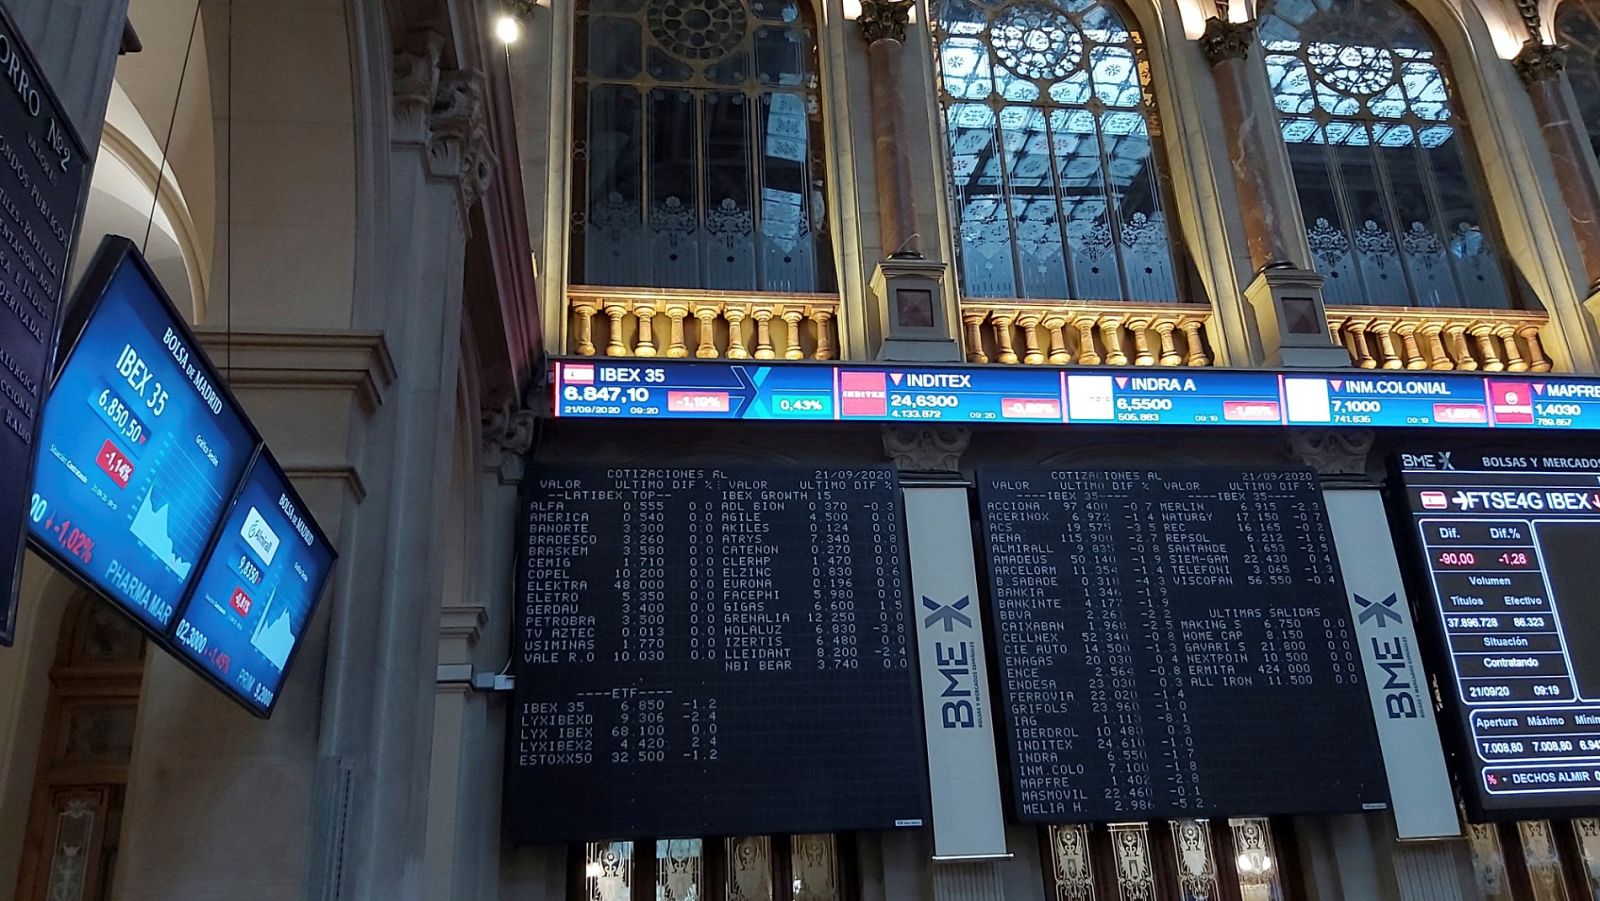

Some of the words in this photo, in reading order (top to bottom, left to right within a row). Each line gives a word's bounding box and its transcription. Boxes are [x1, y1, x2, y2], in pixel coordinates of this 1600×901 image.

[163, 327, 187, 369] BOLSA
[193, 370, 223, 415] MADRID
[600, 368, 641, 382] IBEX
[645, 368, 665, 382] 35
[116, 343, 153, 398] IBEX
[146, 382, 169, 416] 35
[907, 374, 971, 388] INDITEX
[1132, 378, 1181, 391] INDRA
[1183, 379, 1196, 391] A
[1345, 381, 1451, 395] INM.COLONIAL
[1547, 384, 1600, 398] MAPFRE
[564, 387, 649, 403] 6.847,10
[891, 395, 959, 408] 24,6300
[1117, 398, 1172, 411] 6,5500
[564, 406, 620, 415] 21/09/2020
[1332, 401, 1380, 413] 7,1000
[98, 389, 142, 443] 6.850,50
[1402, 454, 1435, 467] BME
[1482, 457, 1527, 467] BOLSAS
[1530, 457, 1538, 467] Y
[105, 452, 133, 482] -1,14%
[607, 469, 703, 478] COTIZACIONES
[815, 470, 891, 480] 21/09/2020
[1242, 472, 1312, 481] 21/09/2020
[540, 480, 581, 489] VALOR
[615, 480, 664, 489] ULTIMO
[672, 480, 695, 489] DIF
[722, 491, 753, 500] IBEX
[761, 491, 808, 500] GROWTH
[817, 491, 831, 500] 15
[987, 502, 1040, 510] ACCIONA
[1467, 492, 1543, 509] FTSE4G
[1545, 493, 1592, 510] IBEX
[530, 502, 564, 511] ALFA
[1160, 503, 1205, 511] MERLIN
[530, 513, 589, 522] AMERICA
[721, 513, 761, 521] AGILE
[989, 513, 1049, 521] ACERINOX
[1161, 513, 1213, 522] NATURGY
[529, 524, 589, 533] BANORTE
[722, 524, 769, 532] AKILES
[990, 523, 1012, 532] ACS
[1164, 523, 1186, 532] REC
[722, 534, 762, 543] ATRYS
[991, 534, 1021, 542] AENA
[1166, 534, 1210, 542] REPSOL
[1439, 528, 1461, 539] Dif.
[1490, 528, 1520, 539] Dif.%
[529, 535, 597, 545] BRADESCO
[529, 546, 588, 556] BRASKEM
[722, 546, 779, 554] CATENON
[992, 545, 1053, 553] ALMIRALL
[1168, 544, 1226, 553] SANTANDE
[528, 558, 571, 567] CEMIG
[722, 557, 771, 565] CLERHP
[993, 555, 1047, 564] AMADEUS
[1169, 555, 1229, 563] SIEM-GAM
[1439, 553, 1475, 565] -90,00
[1499, 553, 1527, 564] -1,28
[527, 569, 570, 579] COPEL
[723, 568, 771, 577] ELZINC
[995, 566, 1057, 575] ARCELORM
[1172, 566, 1230, 574] TELEFONI
[723, 579, 772, 589] EURONA
[1173, 576, 1233, 585] VISCOFAN
[1469, 577, 1511, 586] Volumen
[527, 581, 588, 591] ELEKTRA
[723, 590, 779, 600] FACEPHI
[997, 588, 1044, 597] BANKIA
[527, 593, 579, 603] ELETRO
[1504, 596, 1542, 606] Efectivo
[526, 604, 578, 614] GERDAU
[724, 602, 765, 611] GIGAS
[999, 599, 1061, 609] BANKINTE
[724, 613, 790, 623] GRENALIA
[1000, 611, 1031, 620] BBVA
[1209, 608, 1262, 618] ULTIMAS
[1269, 608, 1321, 617] SALIDAS
[525, 616, 595, 626] PETROBRA
[724, 625, 782, 635] HOLALUZ
[1002, 622, 1064, 632] CAIXABAN
[726, 637, 783, 647] IZERTIS
[1003, 633, 1058, 643] CELLNEX
[1484, 637, 1528, 646] Situación
[524, 640, 595, 650] USIMINAS
[725, 648, 791, 659] LLEIDANT
[1186, 653, 1248, 663] NEXTPOIN
[1006, 656, 1053, 666] ENAGAS
[1484, 658, 1539, 667] Contratando
[1007, 668, 1038, 678] ENCE
[1189, 665, 1235, 675] ERMITA
[1372, 637, 1417, 719] BME
[936, 642, 974, 728] BME
[1008, 680, 1057, 690] ENDESA
[1469, 686, 1510, 697] 21/09/20
[1534, 686, 1560, 696] 09:19
[1010, 692, 1074, 702] FERROVIA
[1011, 703, 1068, 714] GRIFOLS
[521, 714, 593, 726] LYXIBEXD
[1014, 716, 1037, 726] IAG
[1476, 718, 1518, 729] Apertura
[1527, 716, 1564, 726] Máximo
[1015, 728, 1078, 738] IBERDROL
[520, 740, 593, 753] LYXIBEX2
[1017, 740, 1073, 751] INDITEX
[1483, 743, 1523, 754] 7.008,80
[1532, 741, 1572, 752] 7.008,80
[520, 753, 593, 766] ESTOXX50
[1019, 753, 1058, 763] INDRA
[1020, 765, 1084, 776] INM.COLO
[1020, 777, 1069, 788] MAPFRE
[1512, 774, 1556, 783] DECHOS
[1558, 773, 1590, 782] ALMIR
[1022, 790, 1088, 801] MASMOVIL
